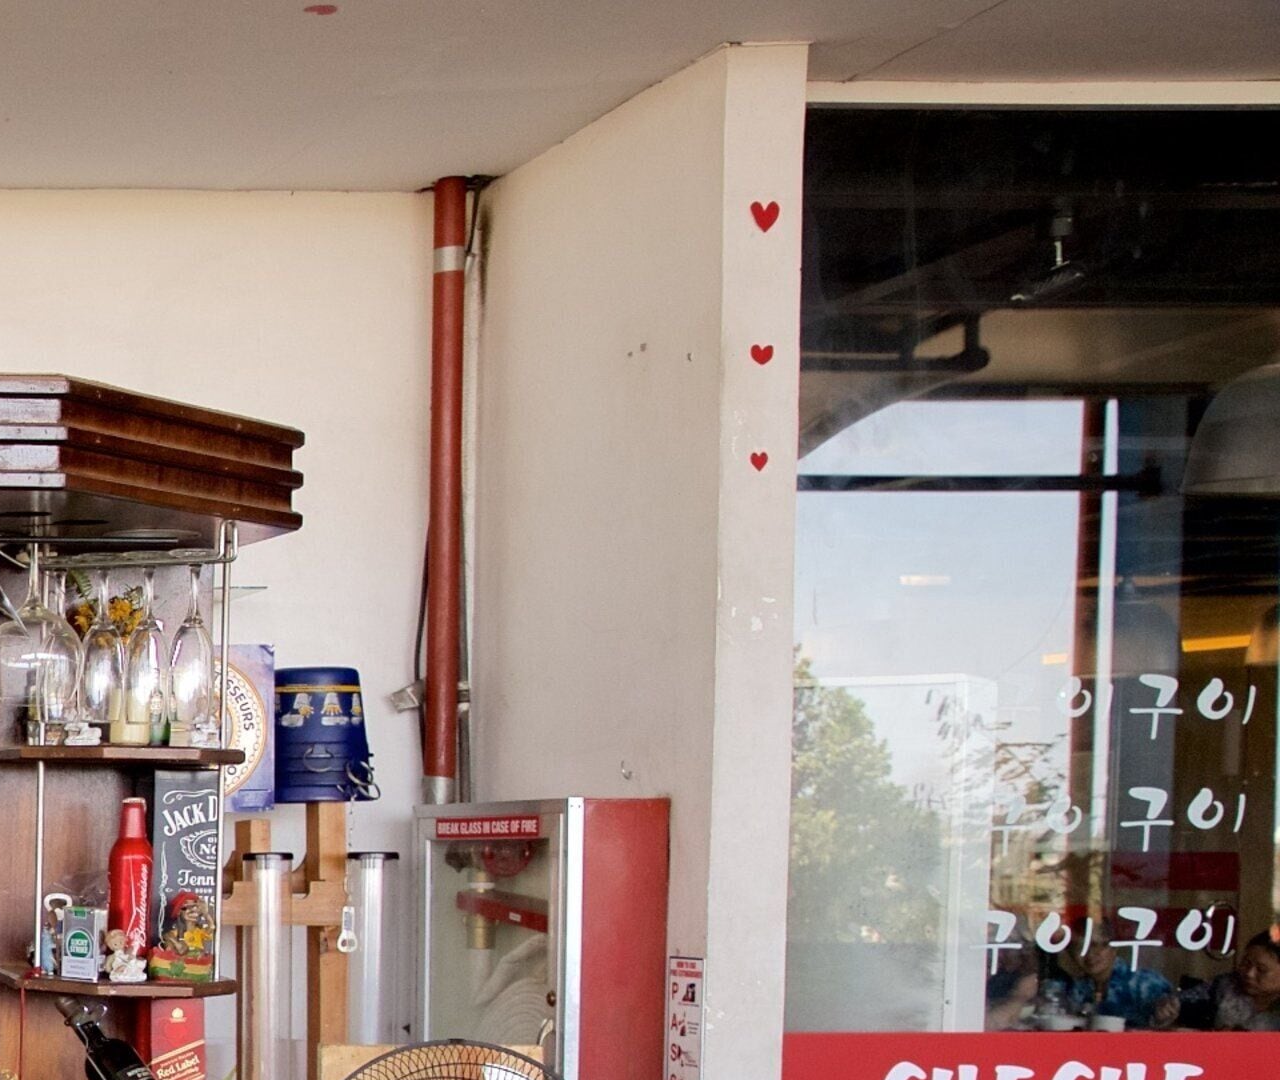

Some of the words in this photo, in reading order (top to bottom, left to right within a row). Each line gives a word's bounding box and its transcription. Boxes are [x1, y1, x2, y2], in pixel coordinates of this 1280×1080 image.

[162, 802, 206, 836] JACK
[437, 822, 459, 834] BREAK
[460, 821, 482, 834] GLASS
[483, 821, 491, 833] IN
[491, 820, 509, 833] CASE
[510, 820, 520, 833] OF
[521, 819, 537, 833] FIRE
[132, 863, 149, 950] Budweiser
[970, 906, 1235, 975] 구이구이
[156, 1066, 175, 1079] Red
[176, 1055, 200, 1070] Label
